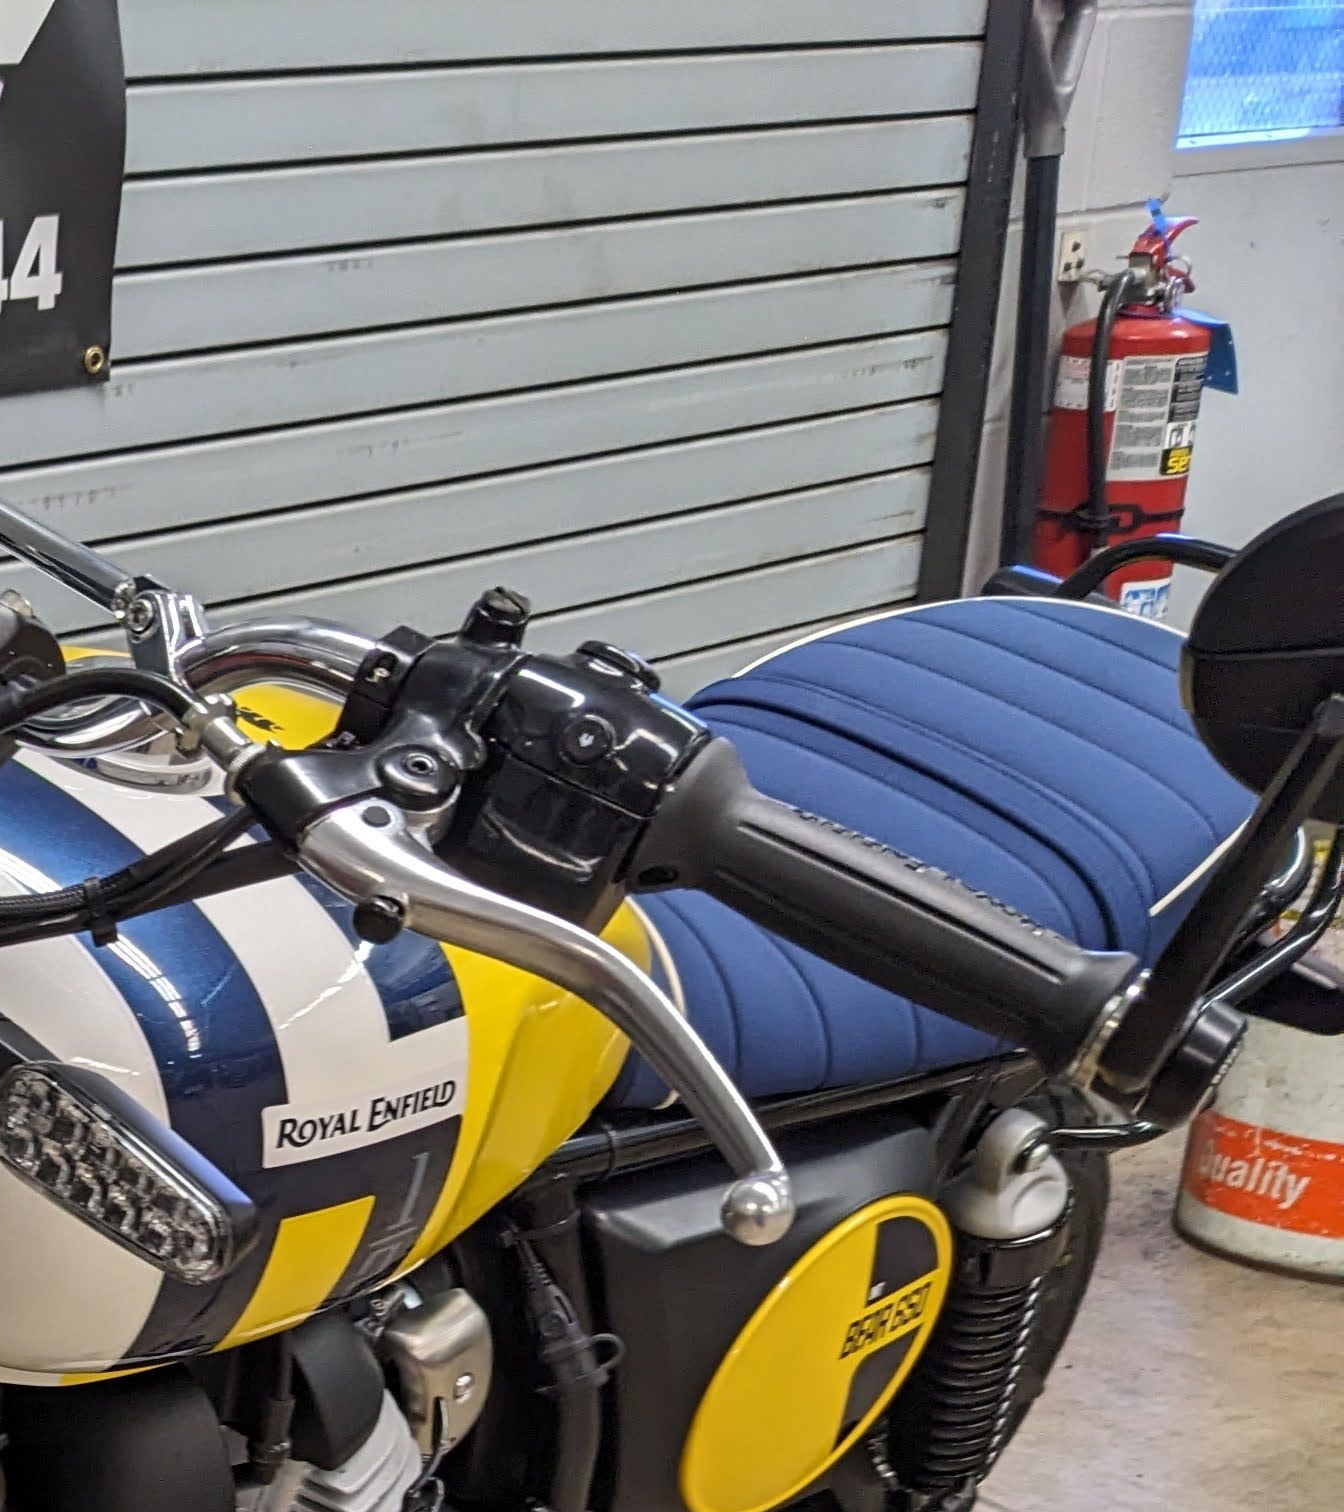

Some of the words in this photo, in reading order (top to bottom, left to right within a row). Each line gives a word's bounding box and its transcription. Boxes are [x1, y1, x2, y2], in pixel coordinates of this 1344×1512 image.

[276, 1108, 362, 1149] ROYAL
[367, 1080, 457, 1133] ENFIELD
[838, 1303, 894, 1361] BEAR
